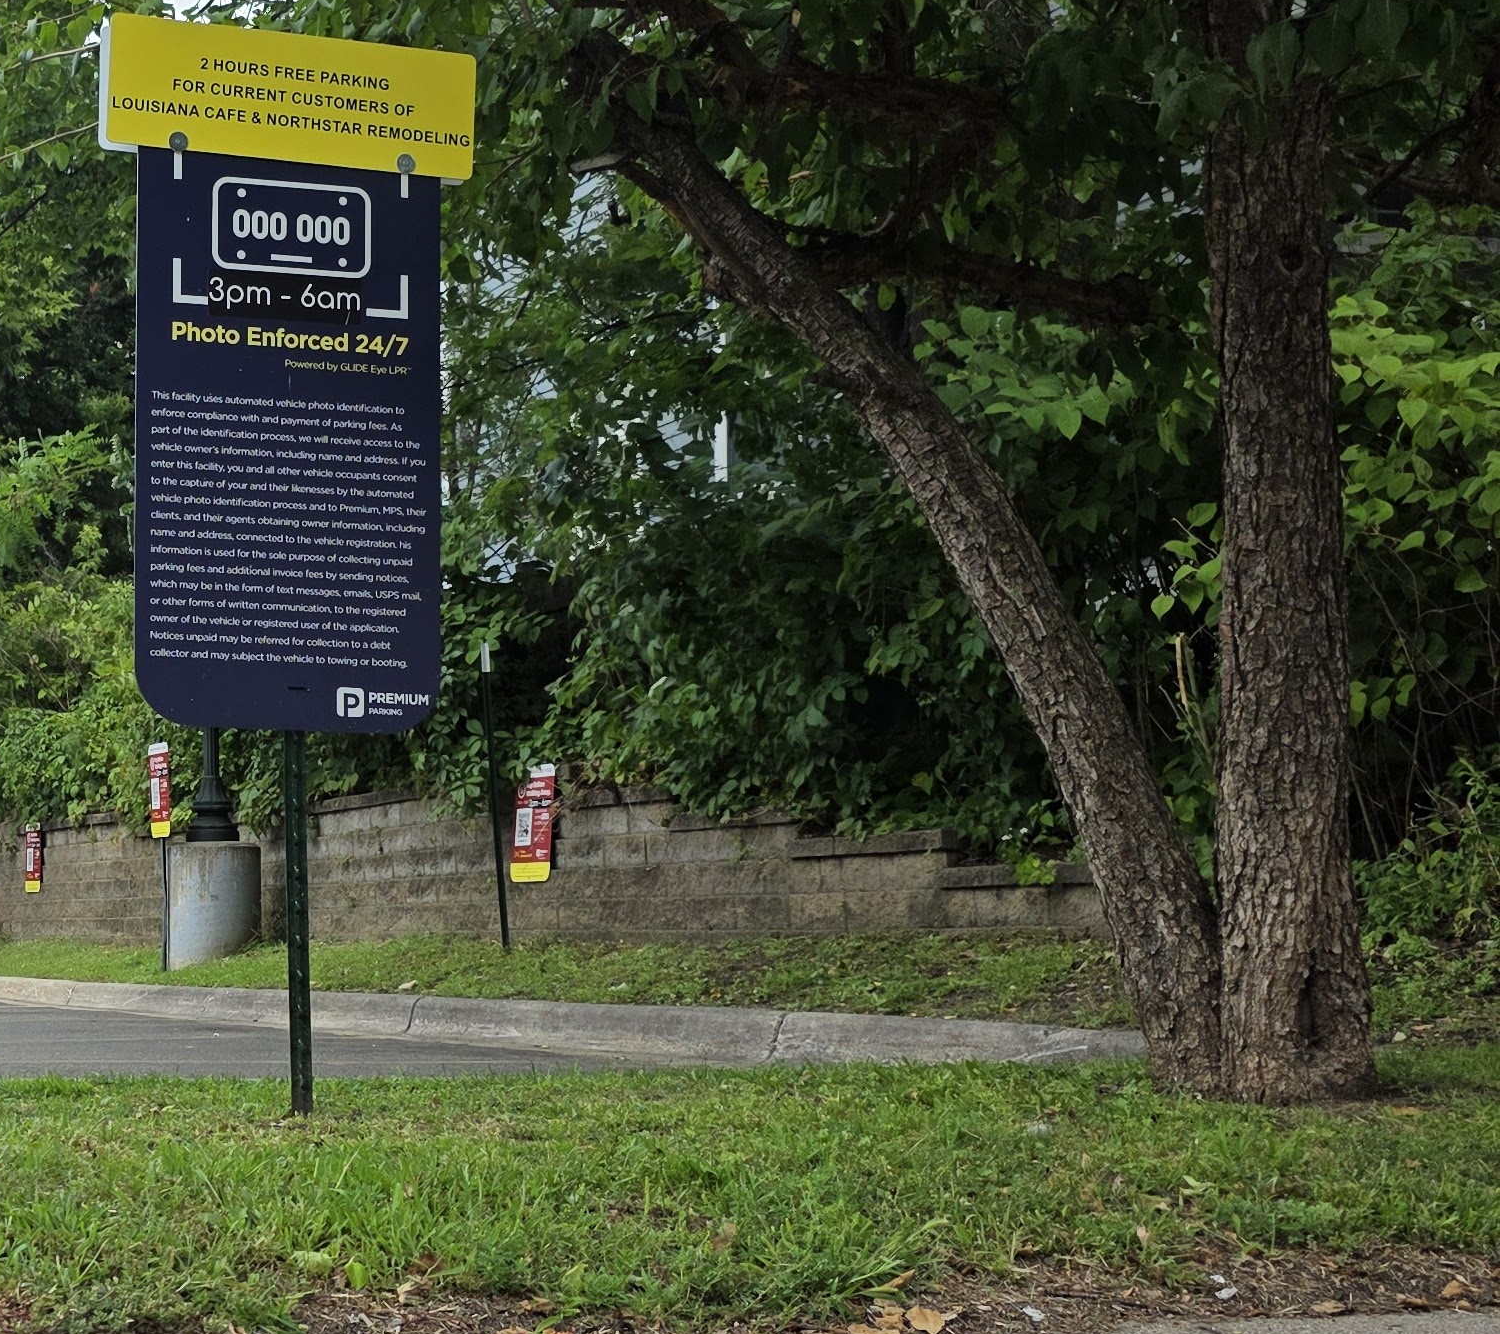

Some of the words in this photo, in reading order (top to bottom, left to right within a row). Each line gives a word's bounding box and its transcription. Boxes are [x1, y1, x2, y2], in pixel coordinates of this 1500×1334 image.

[200, 58, 208, 69] 2
[213, 59, 269, 76] HOURS
[275, 66, 315, 82] FREE
[320, 72, 390, 90] PARKING
[173, 79, 205, 93] FOR
[210, 83, 286, 103] CURRENT
[292, 92, 389, 115] CUSTOMERS
[394, 104, 414, 116] OF
[112, 96, 199, 116] LOUISIANA
[204, 107, 246, 123] CAFE
[252, 111, 261, 124] &
[267, 114, 362, 134] NORTHSTAR
[367, 125, 470, 147] REMODELING
[233, 209, 287, 241] 000
[296, 213, 350, 245] 000
[209, 277, 270, 309] 3pm
[300, 284, 361, 311] 6am
[172, 321, 240, 344] Photo
[248, 327, 348, 352] Enforced
[356, 333, 408, 357] 24/7
[285, 359, 324, 370] Powered
[327, 362, 338, 372] by
[340, 363, 368, 373] GLIDE
[371, 365, 386, 375] Eye
[152, 390, 170, 400] This
[171, 391, 201, 404] facility
[202, 395, 223, 403] uses
[224, 395, 273, 406] automated
[275, 398, 306, 408] vehicle
[307, 400, 335, 412] photo
[336, 402, 393, 414] identification
[395, 405, 404, 414] to
[150, 407, 185, 418] enforce
[186, 409, 238, 423] compliance
[239, 413, 259, 423] with
[261, 414, 278, 424] and
[280, 415, 319, 428] payment
[321, 418, 331, 427] of
[333, 418, 366, 431] parking
[390, 422, 402, 431] As
[150, 425, 170, 436] part
[171, 426, 181, 435] of
[183, 426, 198, 436] the
[200, 427, 258, 439] identification
[298, 435, 311, 443] we
[313, 434, 328, 443] will
[330, 435, 361, 445] receive
[362, 439, 392, 447] access
[393, 439, 403, 448] to
[405, 439, 420, 449] the
[150, 442, 182, 452] vehicle
[183, 443, 219, 454] owner's
[275, 449, 316, 462] including
[318, 453, 343, 461] name
[344, 453, 361, 462] and
[401, 456, 407, 465] If
[409, 459, 425, 468] you
[150, 459, 174, 469] enter
[176, 460, 193, 470] this
[226, 465, 243, 475] you
[245, 464, 263, 474] and
[264, 465, 274, 474] all
[276, 466, 301, 476] other
[302, 467, 333, 478] vehicle
[334, 469, 380, 482] occupants
[382, 472, 416, 482] consent
[150, 476, 160, 485] to
[162, 477, 177, 486] the
[179, 477, 214, 490] capture
[215, 479, 225, 489] of
[227, 482, 248, 492] your
[249, 481, 266, 491] and
[268, 482, 289, 492] their
[290, 484, 335, 495] likenesses
[336, 486, 348, 497] by
[349, 487, 364, 496] the
[365, 488, 414, 499] automated
[150, 493, 182, 503] vehicle
[183, 495, 211, 507] photo
[212, 496, 271, 508] identification
[272, 502, 307, 512] process
[308, 502, 326, 511] and
[327, 503, 337, 512] to
[405, 507, 425, 517] their
[182, 512, 200, 521] and
[202, 513, 223, 523] their
[224, 514, 255, 526] agents
[257, 516, 299, 529] obtaining
[301, 520, 329, 528] owner
[385, 523, 425, 535] including
[149, 529, 176, 537] name
[177, 529, 195, 538] and
[235, 532, 283, 543] connected
[284, 534, 295, 543] to
[296, 535, 311, 544] the
[313, 536, 344, 546] vehicle
[399, 540, 411, 549] his
[149, 544, 202, 556] information
[203, 547, 211, 556] is
[212, 548, 235, 557] used
[236, 549, 250, 558] for
[251, 550, 266, 559] the
[268, 550, 287, 560] sole
[288, 553, 325, 564] purpose
[326, 553, 336, 562] of
[338, 554, 380, 567] collecting
[382, 556, 412, 568] unpaid
[369, 692, 429, 706] PREMIUM
